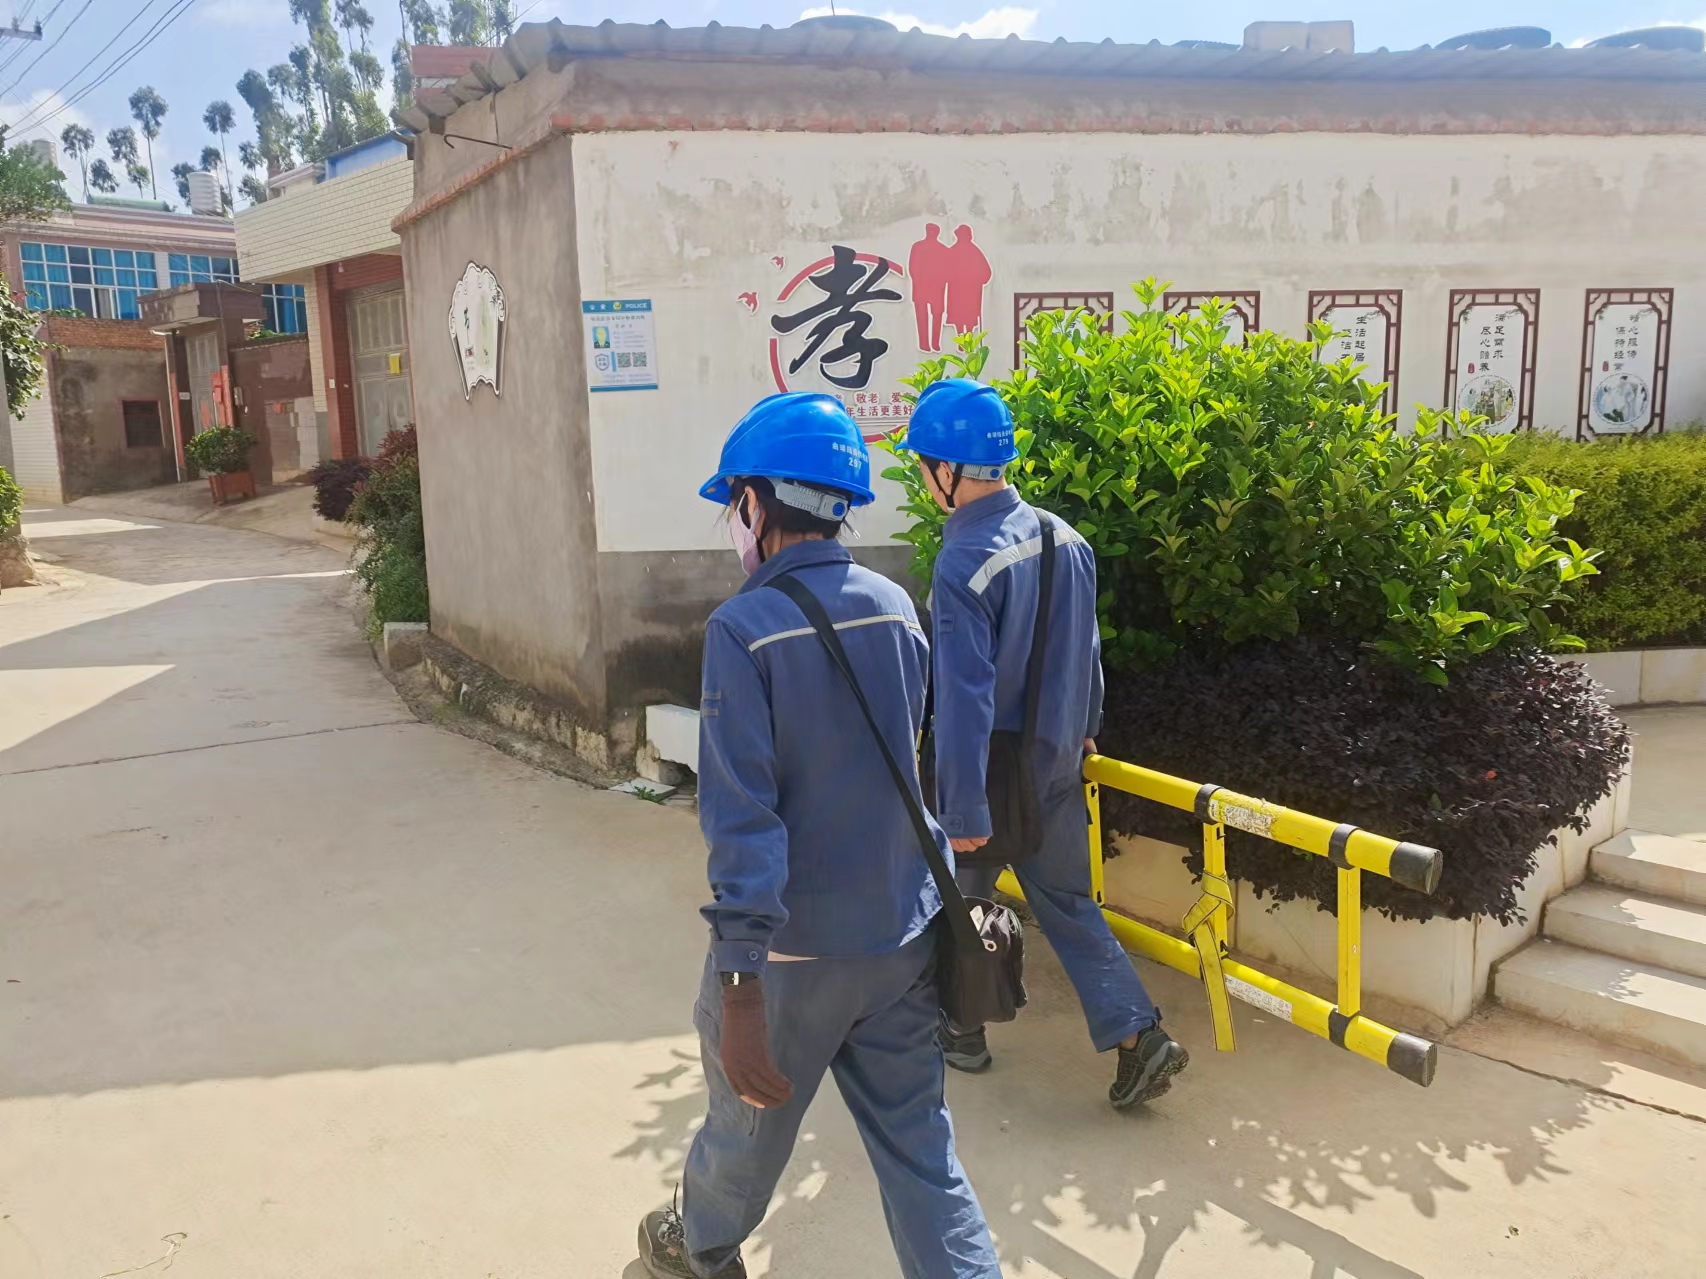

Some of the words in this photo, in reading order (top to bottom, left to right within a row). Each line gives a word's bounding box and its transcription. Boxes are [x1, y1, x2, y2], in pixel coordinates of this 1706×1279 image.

[771, 245, 903, 390] 孝
[1354, 316, 1367, 362] 生活起居
[856, 392, 879, 404] 敬老
[848, 456, 862, 470] 297
